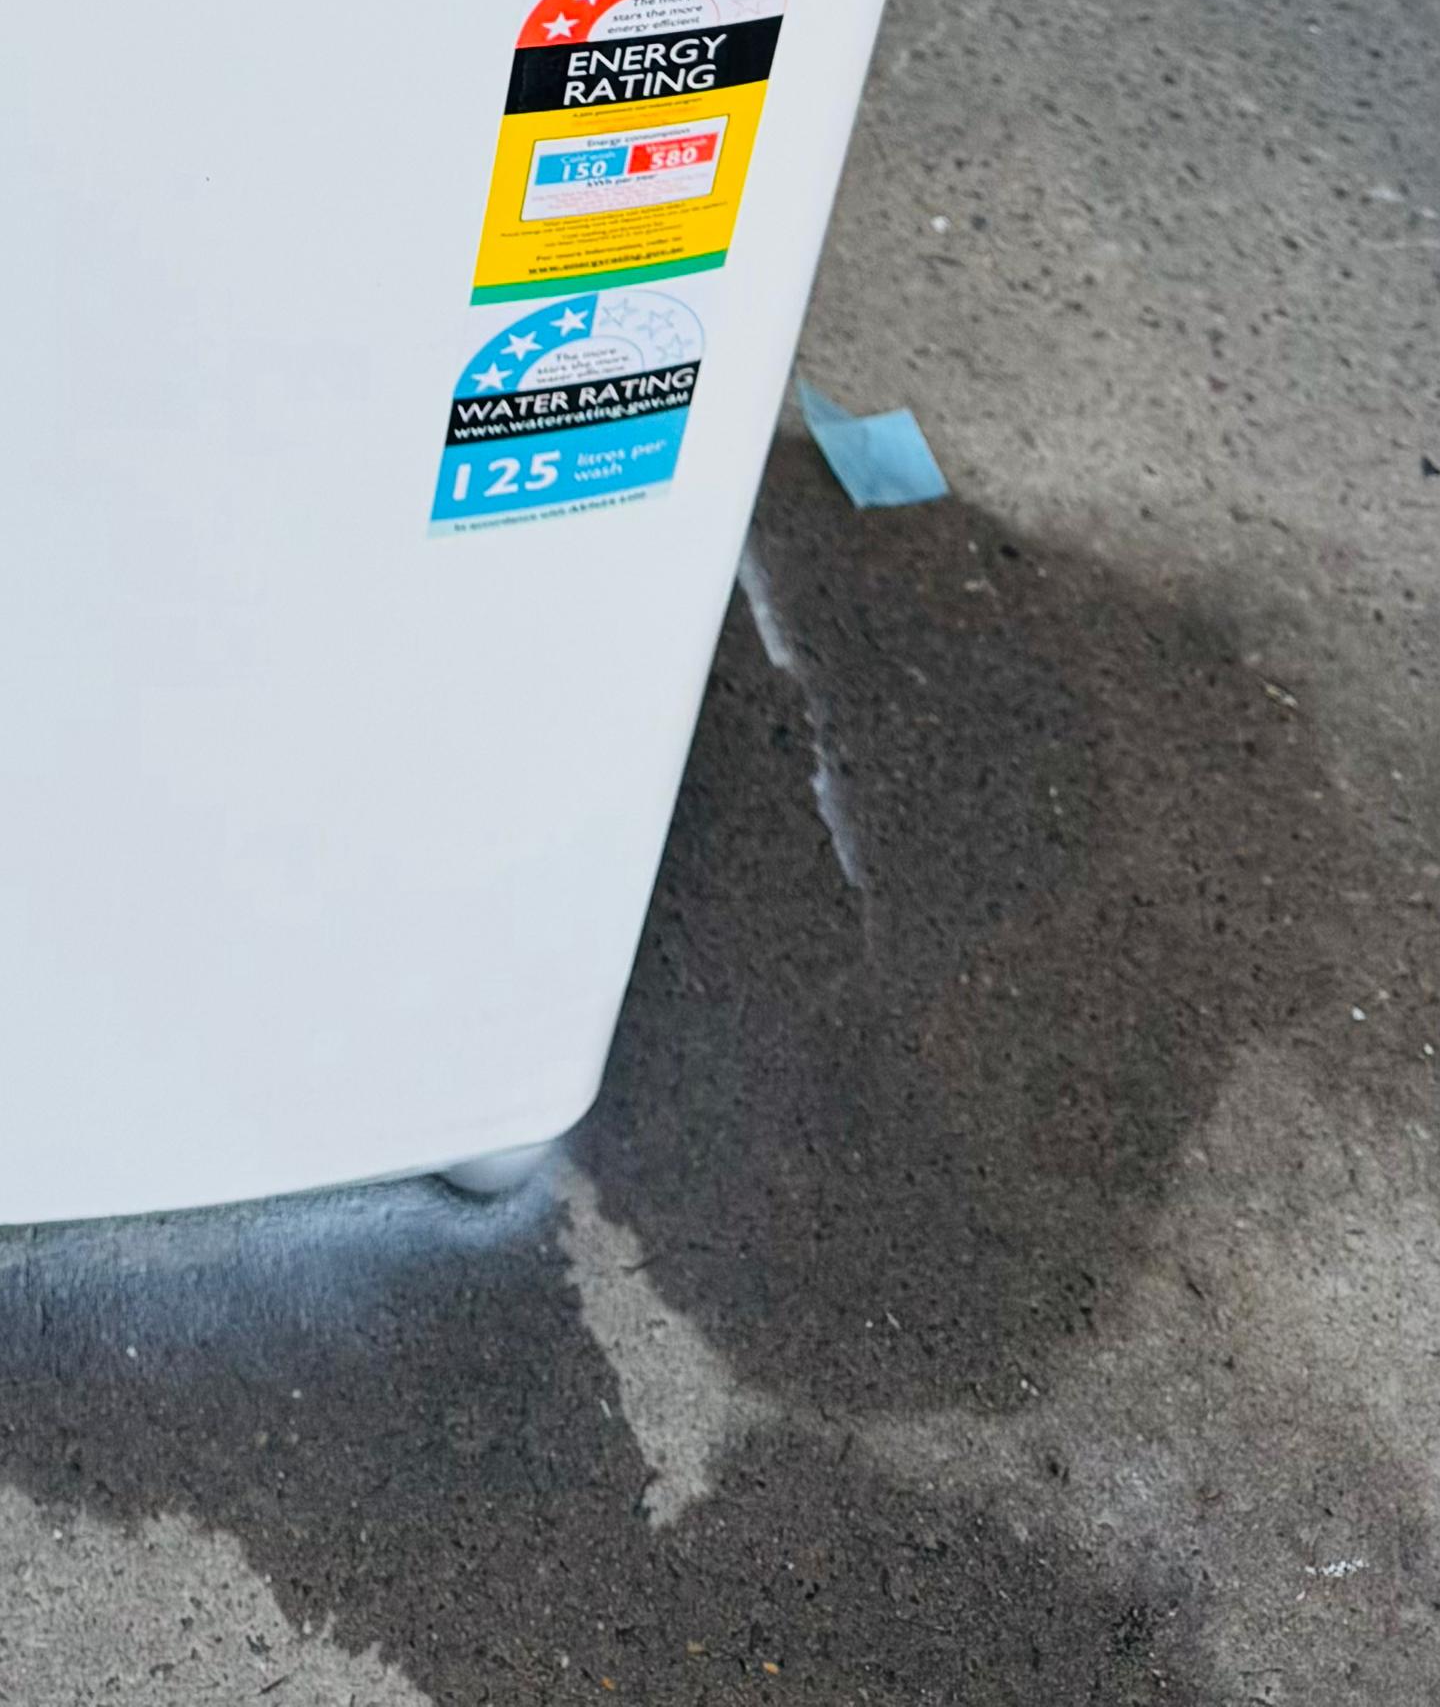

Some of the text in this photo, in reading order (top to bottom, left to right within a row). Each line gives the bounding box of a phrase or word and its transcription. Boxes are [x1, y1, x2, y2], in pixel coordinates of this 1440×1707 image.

[613, 4, 703, 23] stars the more
[607, 16, 701, 35] energy efficient
[567, 33, 728, 77] ENERGY
[563, 64, 717, 106] RATING
[587, 137, 621, 148] Energy
[650, 147, 698, 170] 580
[562, 160, 608, 181] 150
[457, 366, 696, 424] WATER RATING
[453, 391, 690, 440] www.waterrating.gov.au
[452, 439, 668, 501] 125 litres per
[574, 464, 623, 482] wash
